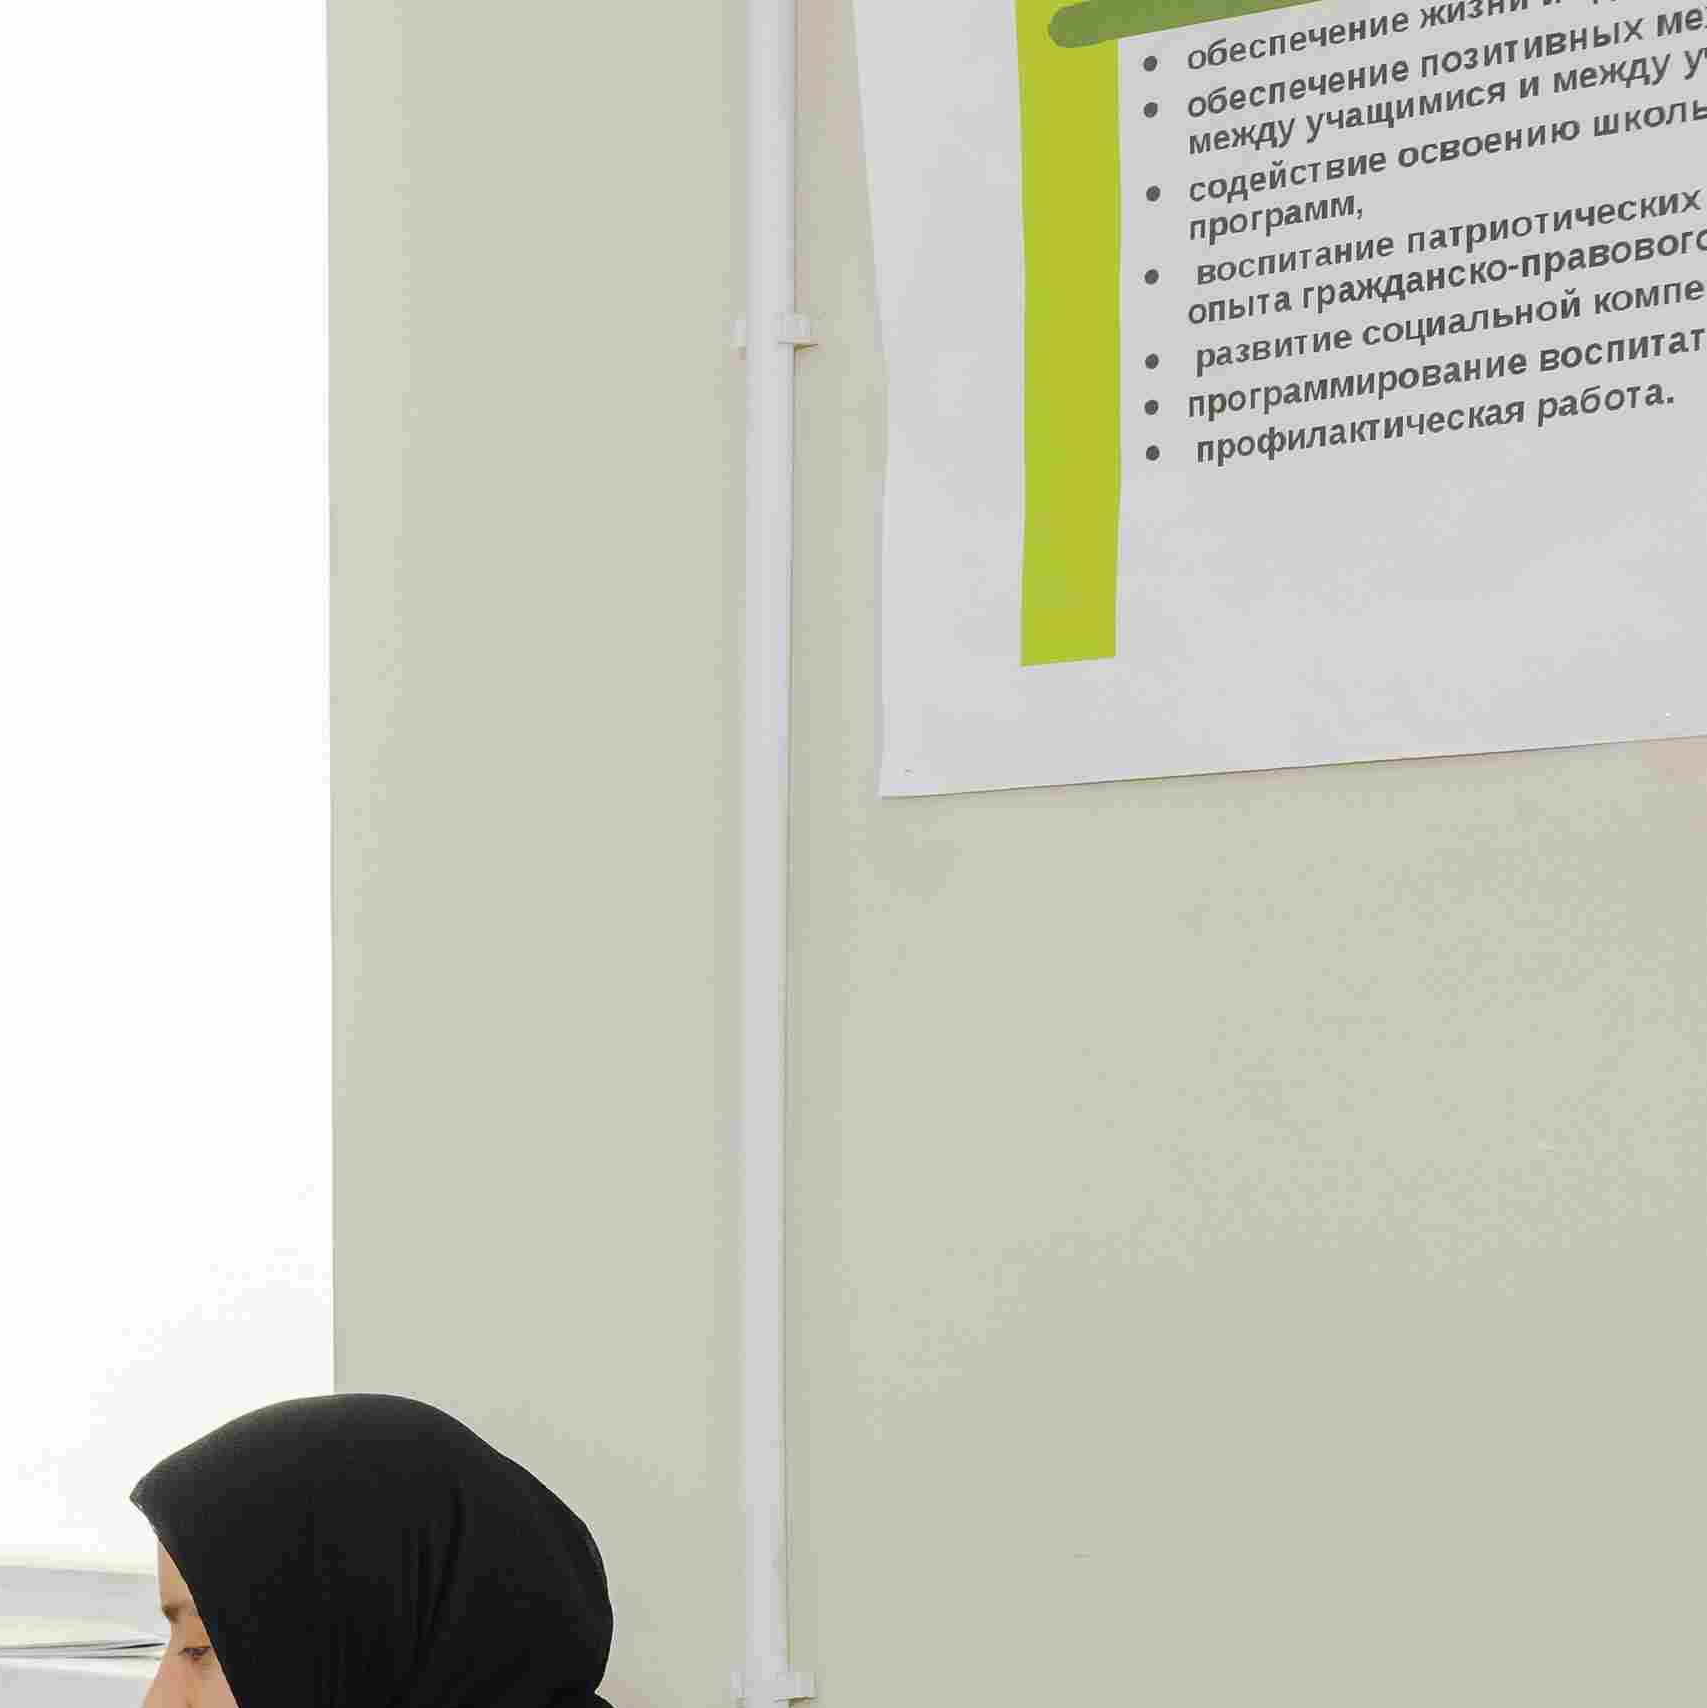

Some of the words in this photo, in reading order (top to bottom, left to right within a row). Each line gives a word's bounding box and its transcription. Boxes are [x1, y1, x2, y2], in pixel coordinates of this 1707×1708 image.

[1188, 10, 1410, 70] обеспечение
[1188, 61, 1409, 118] обеспечение
[1422, 18, 1643, 78] позитивных
[1657, 8, 1707, 37] ме
[1189, 115, 1296, 155] между
[1305, 82, 1506, 144] учащимися
[1519, 76, 1540, 100] и
[1553, 53, 1671, 93] между
[1189, 148, 1387, 204] содействие
[1397, 120, 1581, 170] освоению
[1190, 194, 1364, 246] программ,
[1197, 236, 1395, 286] воспитание
[1408, 189, 1702, 254] патриотических
[1188, 289, 1292, 325] опыта
[1196, 326, 1353, 378] развитие
[1362, 288, 1582, 351] социальной
[1594, 279, 1705, 315] компе
[1189, 354, 1528, 422] программирование
[1540, 327, 1706, 372] воспитат
[1197, 400, 1526, 468] профилактическая
[1538, 383, 1676, 428] работа.
